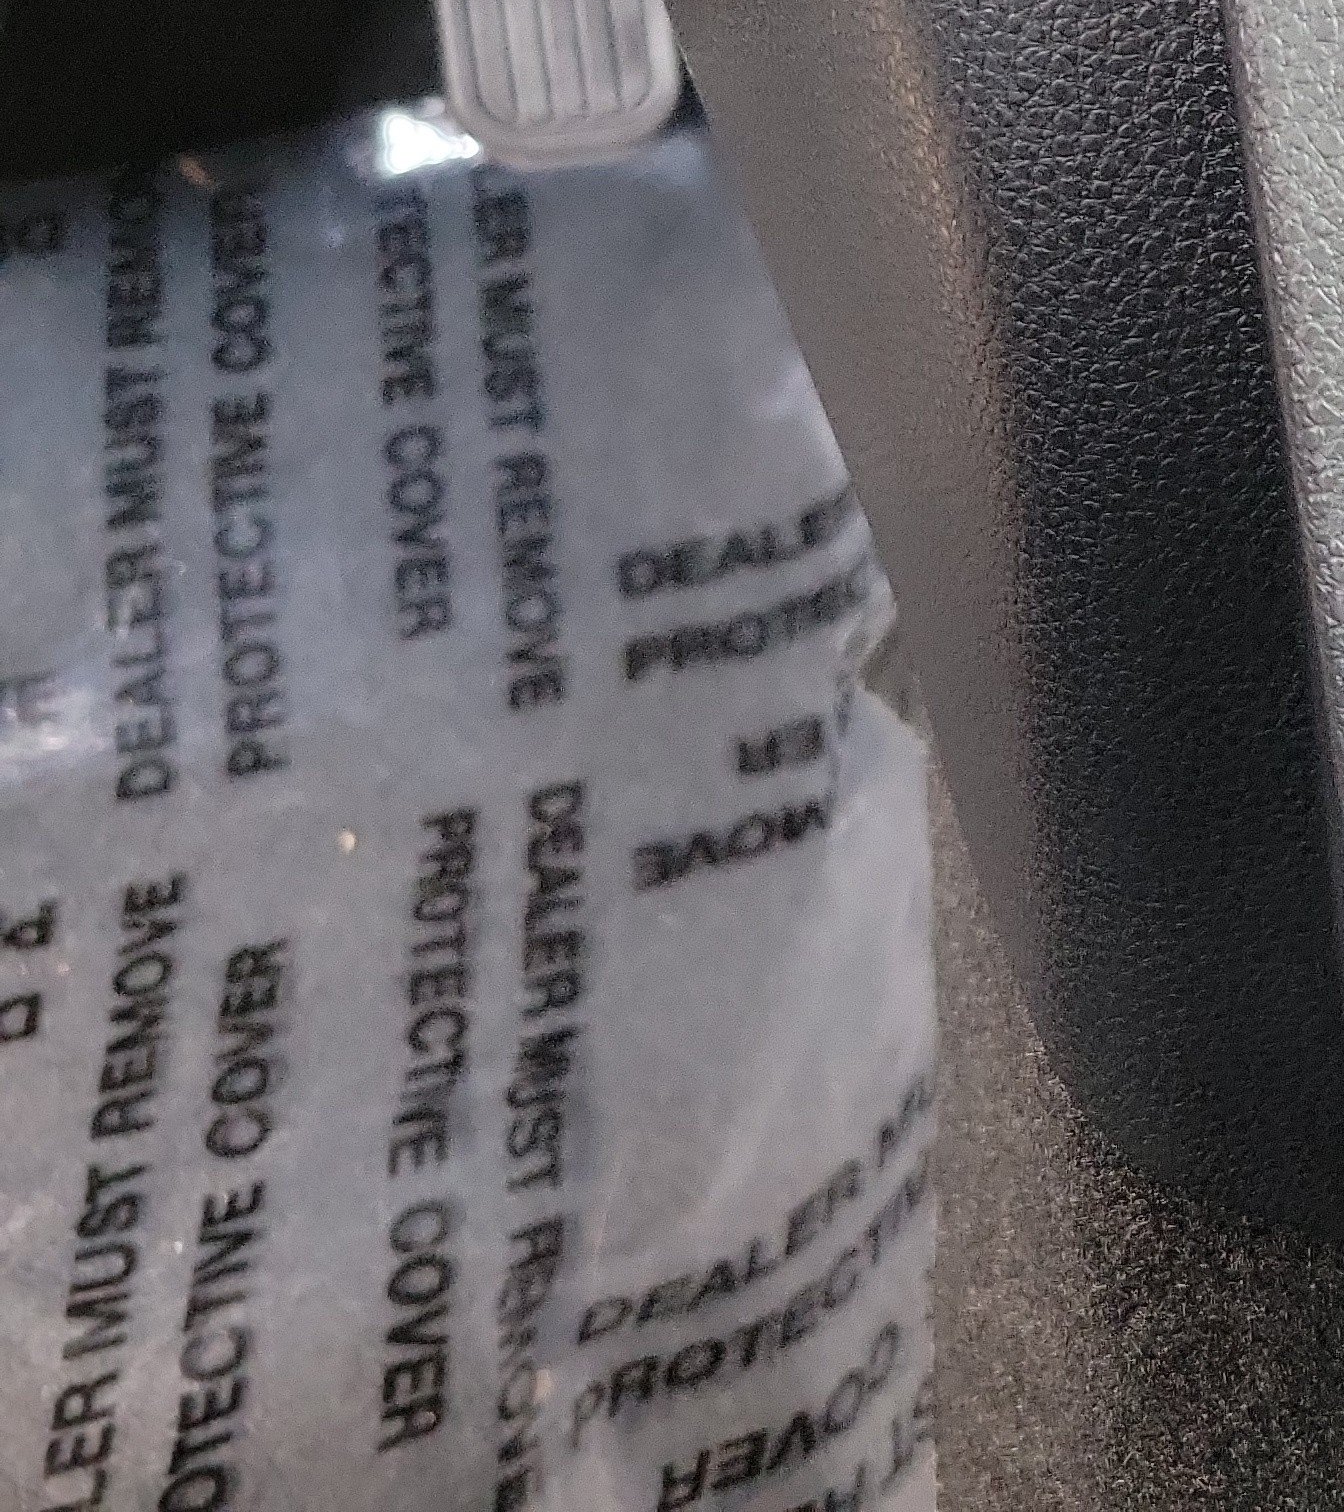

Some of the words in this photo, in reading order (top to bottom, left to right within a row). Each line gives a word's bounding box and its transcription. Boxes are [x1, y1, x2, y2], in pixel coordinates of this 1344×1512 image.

[375, 180, 438, 406] TECTIVE
[472, 164, 530, 263] LER
[105, 368, 166, 530] MUST
[478, 270, 546, 433] MUST
[210, 393, 288, 778] PROTECTIVE
[383, 426, 452, 640] COVER
[496, 453, 566, 713] REMOVE
[107, 543, 178, 800] DEALER
[523, 778, 585, 1018] DEALER
[632, 800, 832, 890] MOVE
[90, 873, 187, 1143] REMOVE
[205, 938, 290, 1160] COVER
[388, 806, 478, 1180] PROTECTIVE
[507, 1026, 575, 1194] MUST
[62, 1163, 145, 1363] MUST
[157, 1183, 265, 1512] OTECTIVE
[378, 1196, 452, 1453] COVER
[578, 1158, 862, 1346] DEALER
[38, 1373, 118, 1512] LER
[657, 1322, 898, 1512] COVER
